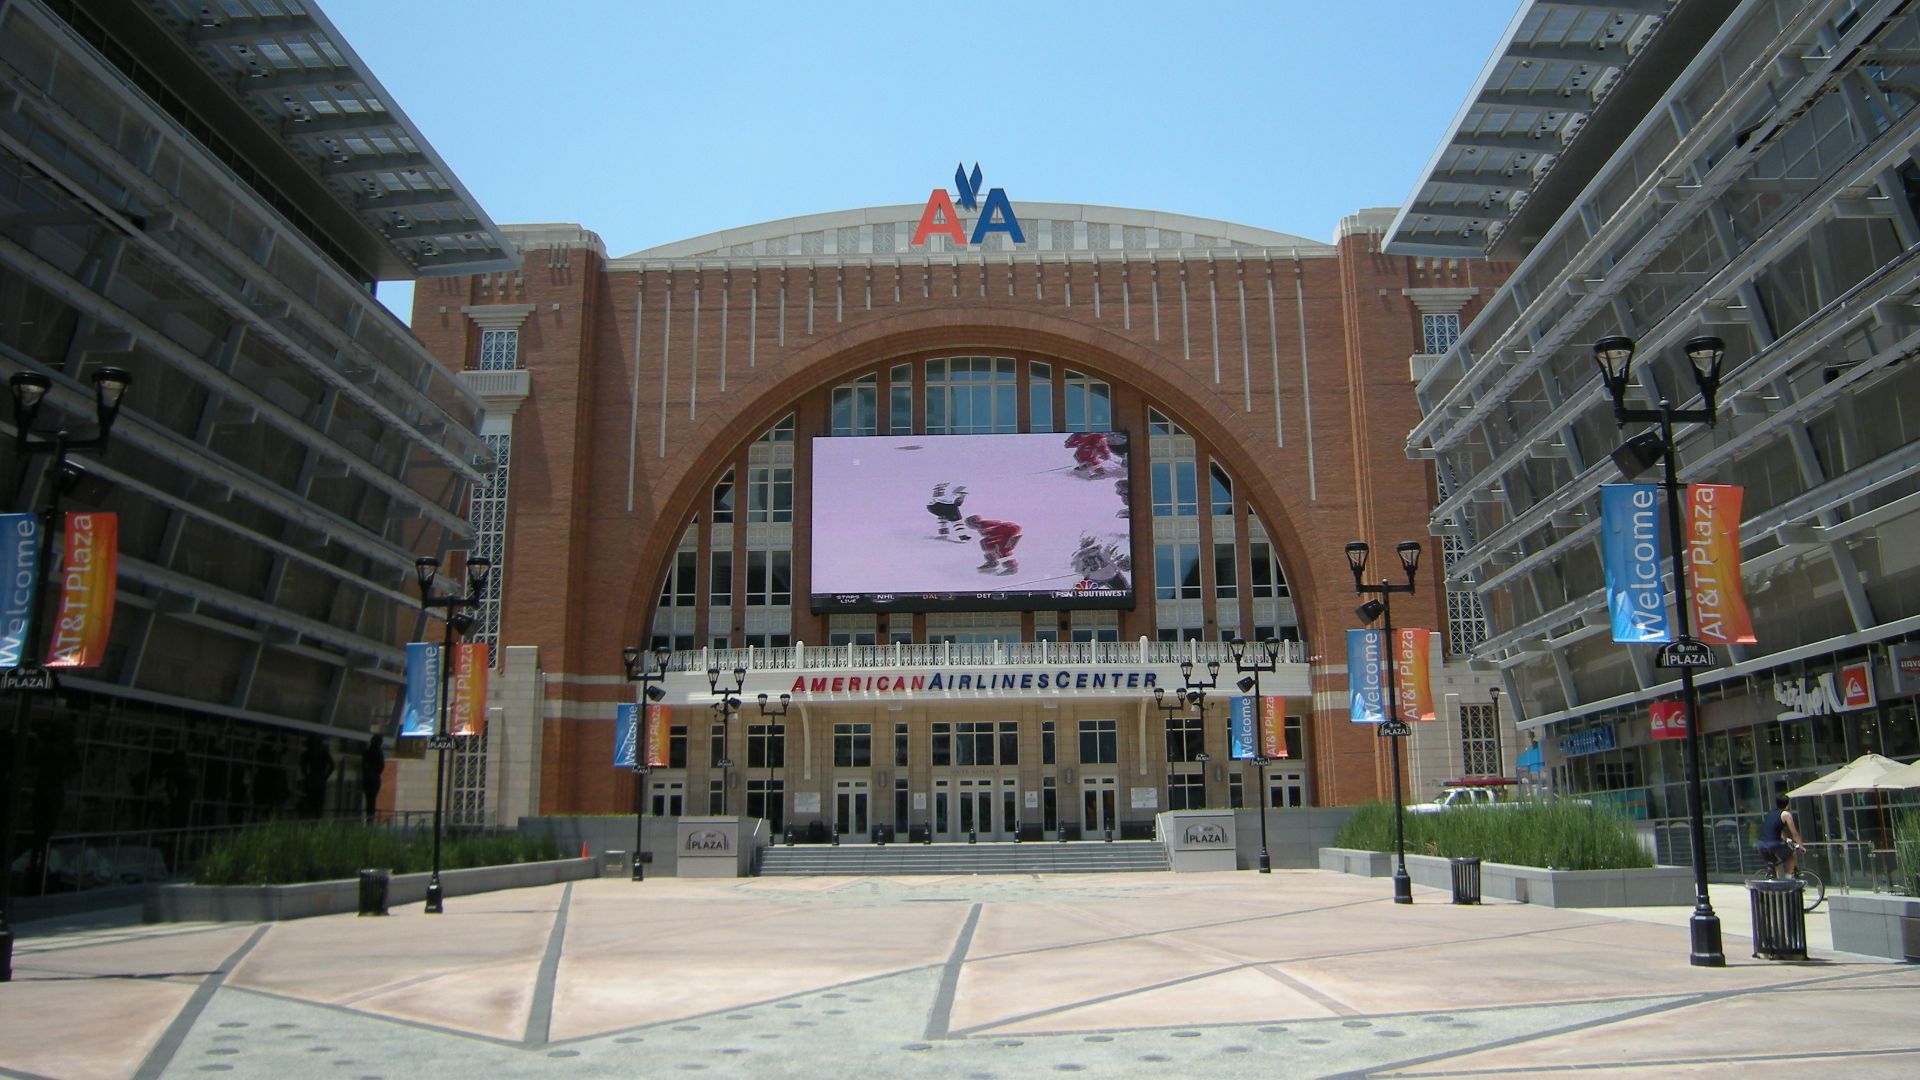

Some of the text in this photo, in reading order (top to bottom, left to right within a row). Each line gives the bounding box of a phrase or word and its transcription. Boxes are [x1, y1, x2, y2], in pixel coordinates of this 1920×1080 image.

[0, 519, 36, 665] Welcome
[54, 514, 93, 662] AT&T Plaza
[1078, 590, 1127, 598] SOUTHWEST
[1631, 489, 1665, 641] Welcome
[1690, 487, 1728, 641] AT&T Plaza
[8, 677, 44, 688] PLAZA
[416, 646, 438, 733] Welcome
[454, 643, 473, 732] AT&T Plaza
[790, 671, 1157, 692] AMERICAN AIRLINES CENTER
[1363, 632, 1382, 720] Welcome
[1400, 630, 1419, 720] AT&T Plaza
[1670, 654, 1708, 665] PLAZA
[625, 704, 638, 765] Welcome
[1241, 698, 1253, 756] Welcome
[1265, 696, 1276, 756] AT&T Plaza
[692, 840, 723, 849] PLAZA
[1189, 834, 1221, 843] PLAZA
